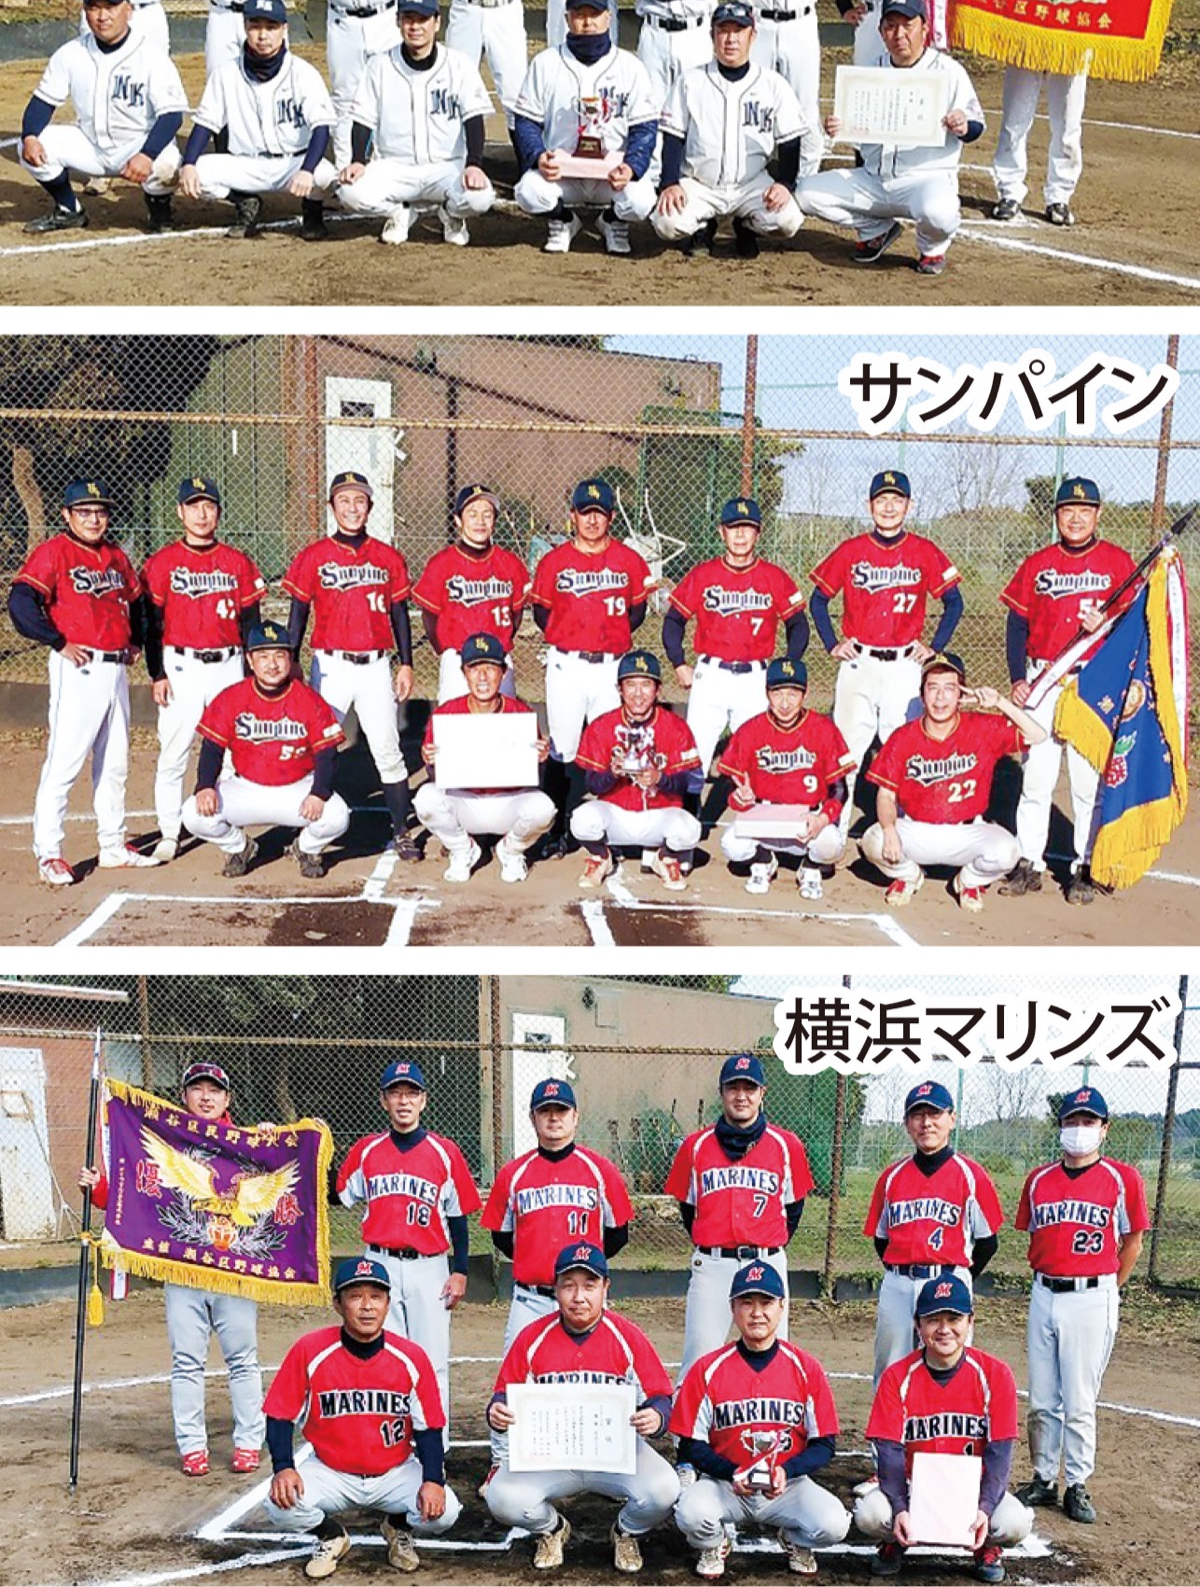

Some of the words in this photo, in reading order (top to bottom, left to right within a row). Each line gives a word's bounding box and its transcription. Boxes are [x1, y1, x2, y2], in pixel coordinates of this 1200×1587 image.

[111, 73, 146, 109] NK
[429, 87, 464, 122] NK
[741, 100, 775, 135] NK
[603, 596, 627, 617] 19
[892, 593, 918, 615] 27
[752, 616, 765, 637] 7
[802, 774, 818, 794] 9
[947, 779, 978, 804] 22
[368, 1173, 439, 1206] MARINES
[701, 1165, 780, 1197] MARINES
[406, 1201, 431, 1227] 18
[517, 1183, 598, 1217] MARINES
[752, 1191, 769, 1219] 7
[888, 1197, 963, 1230] MARINES
[1033, 1198, 1110, 1230] MARINES
[566, 1210, 590, 1235] 11
[928, 1225, 943, 1251] 4
[1072, 1228, 1105, 1255] 23
[318, 1388, 411, 1420] MARINES
[714, 1396, 806, 1432] MARINES
[380, 1417, 406, 1448] 12
